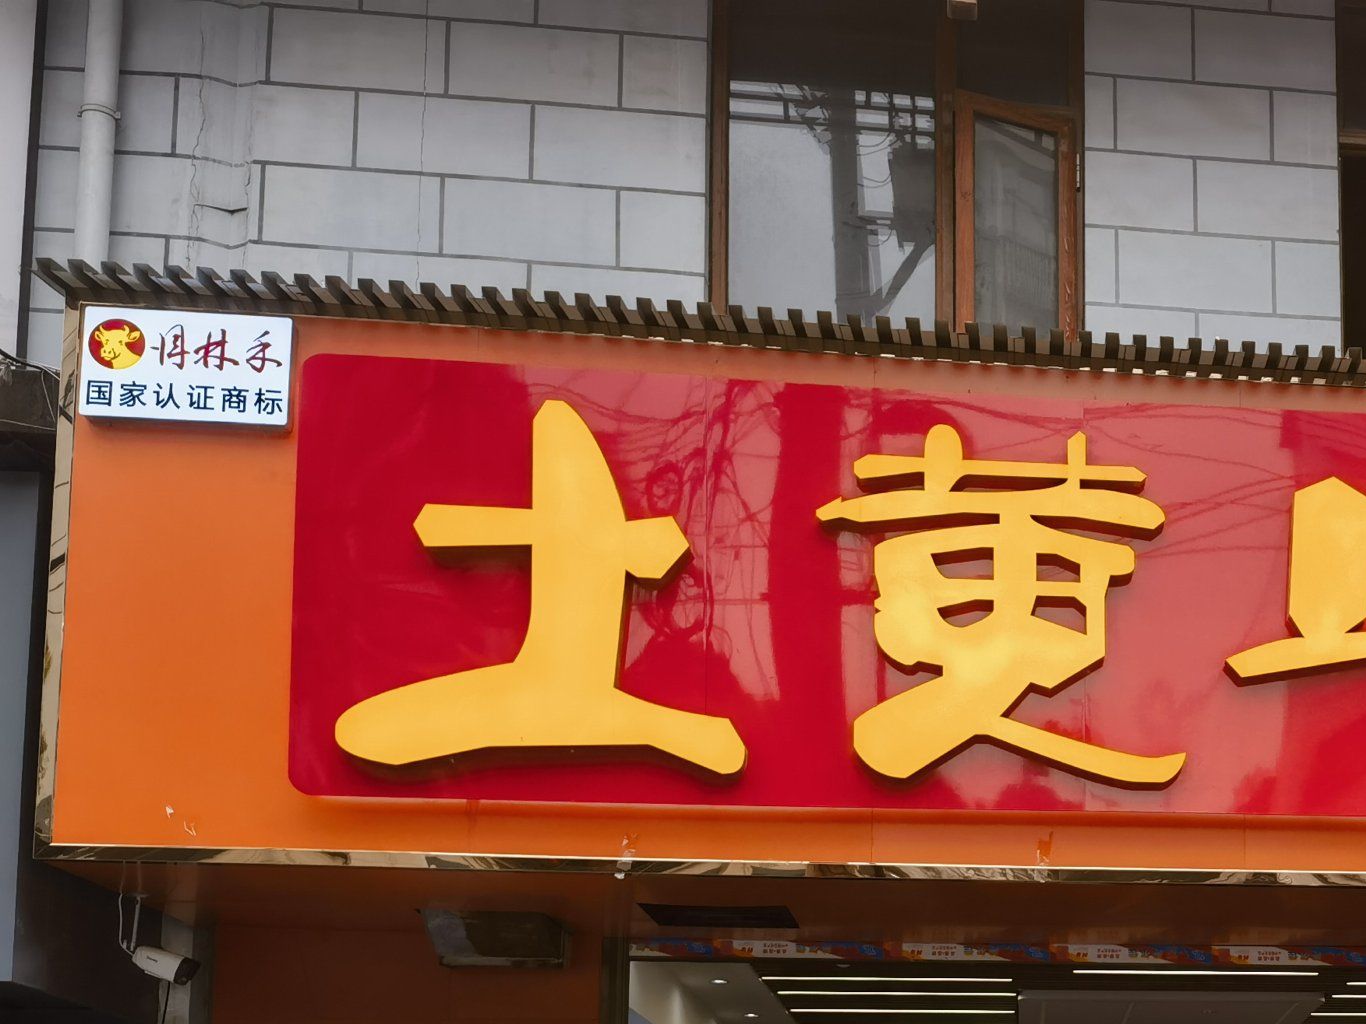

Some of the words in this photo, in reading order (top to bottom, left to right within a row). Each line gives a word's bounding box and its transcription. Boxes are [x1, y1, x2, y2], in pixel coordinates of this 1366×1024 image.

[85, 379, 283, 415] 国家认证商标
